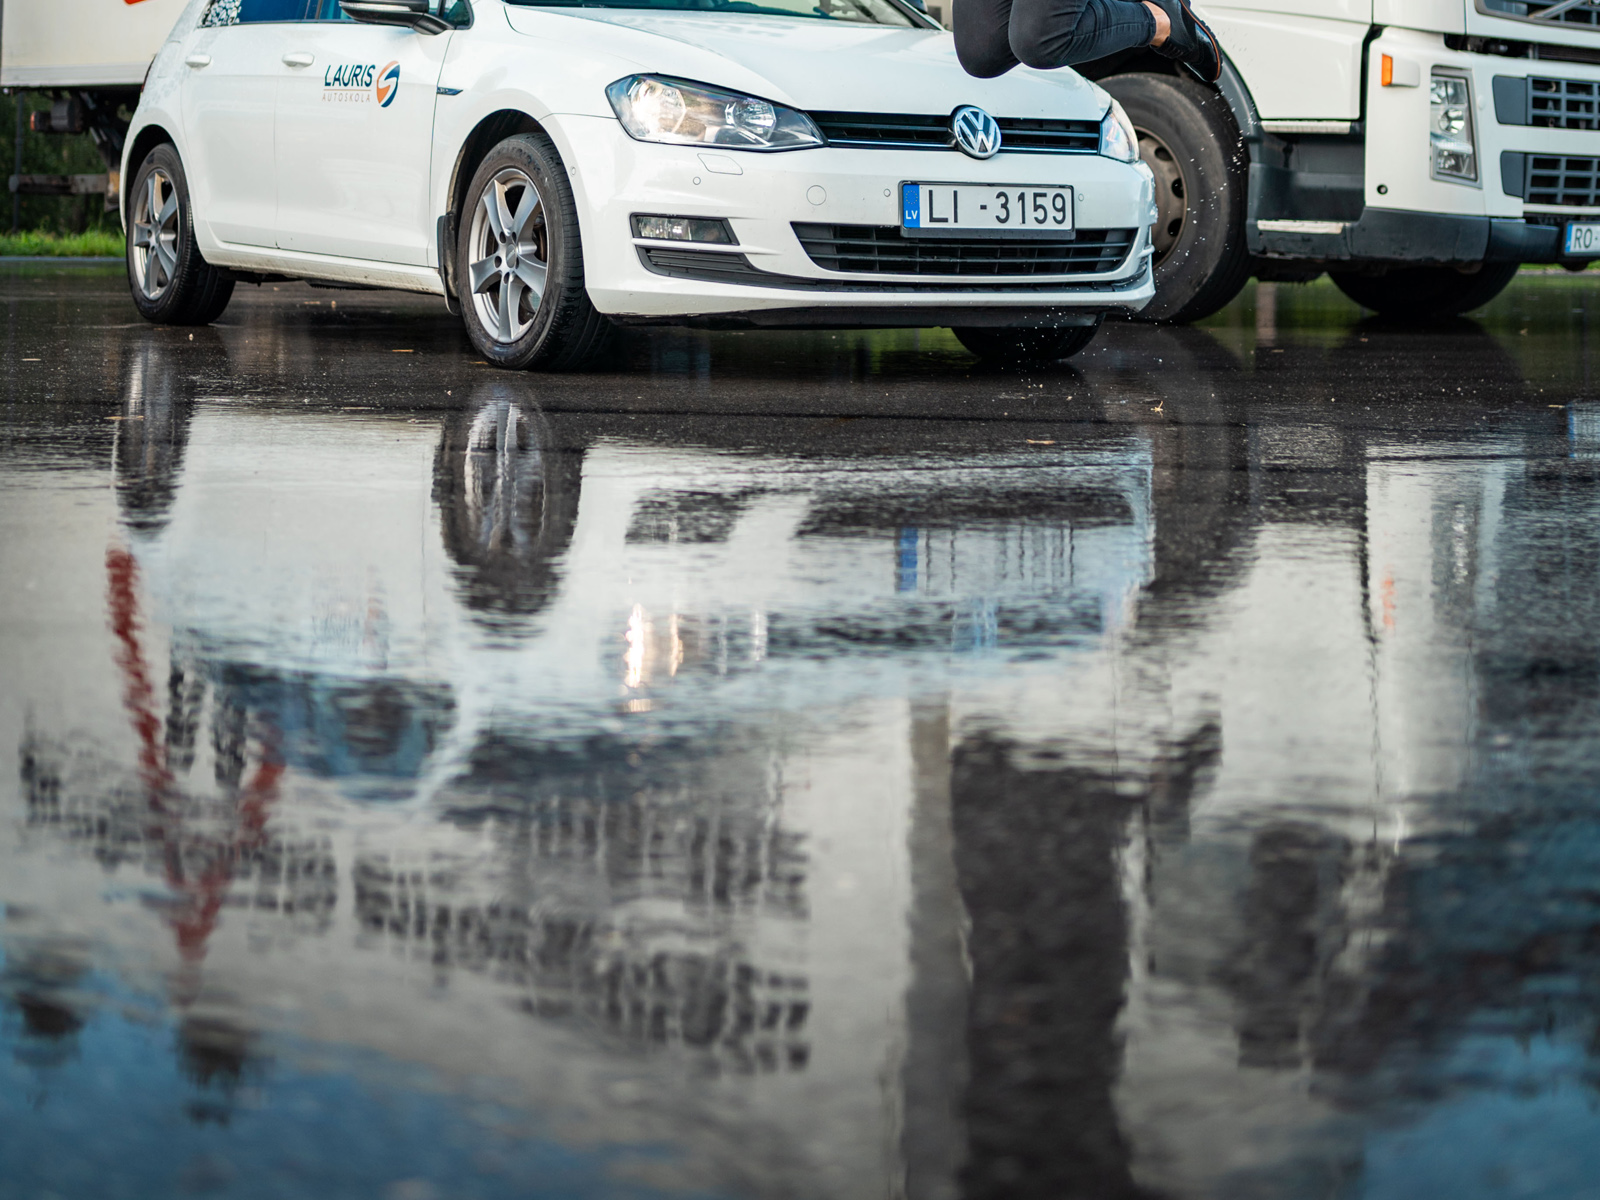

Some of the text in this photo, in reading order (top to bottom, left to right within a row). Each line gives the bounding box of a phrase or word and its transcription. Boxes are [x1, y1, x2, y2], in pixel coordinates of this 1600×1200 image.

[324, 64, 376, 87] LAURIS
[322, 92, 371, 103] AUTOSKOLA
[905, 210, 918, 220] LV
